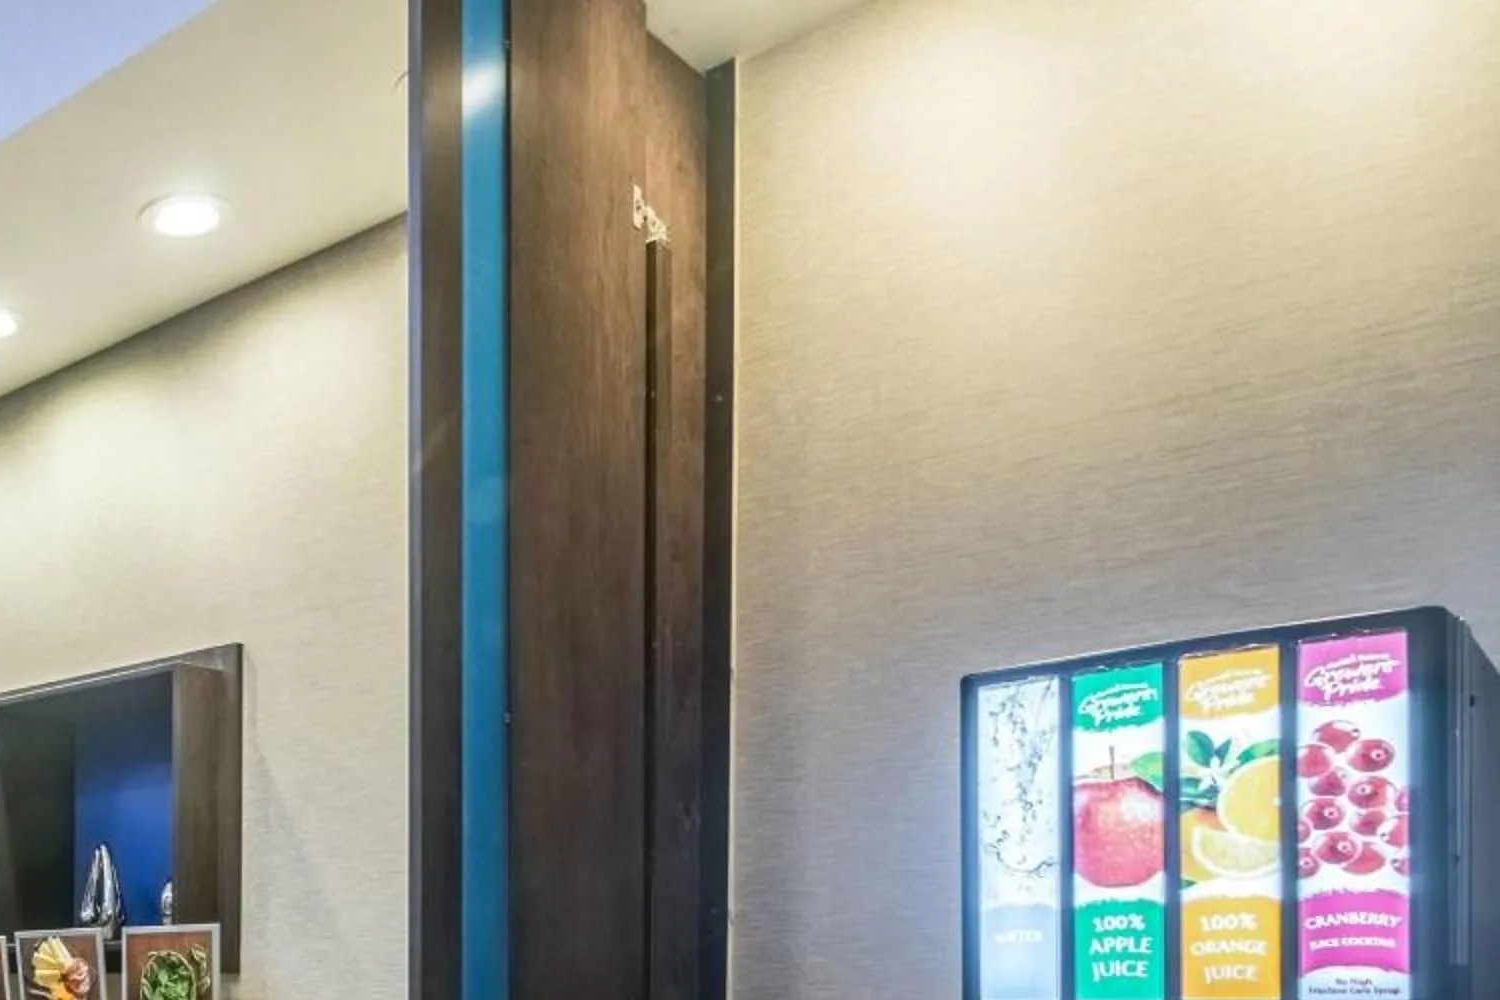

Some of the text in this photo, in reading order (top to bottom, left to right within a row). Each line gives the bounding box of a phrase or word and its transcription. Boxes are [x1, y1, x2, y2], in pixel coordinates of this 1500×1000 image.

[1092, 912, 1146, 933] 100%
[1200, 911, 1258, 932] 100%
[1304, 910, 1403, 930] CRANBERRY
[1089, 935, 1155, 957] APPLE
[1189, 939, 1269, 957] ORANGE
[1090, 959, 1150, 983] JUICE
[1203, 964, 1259, 986] JUICE
